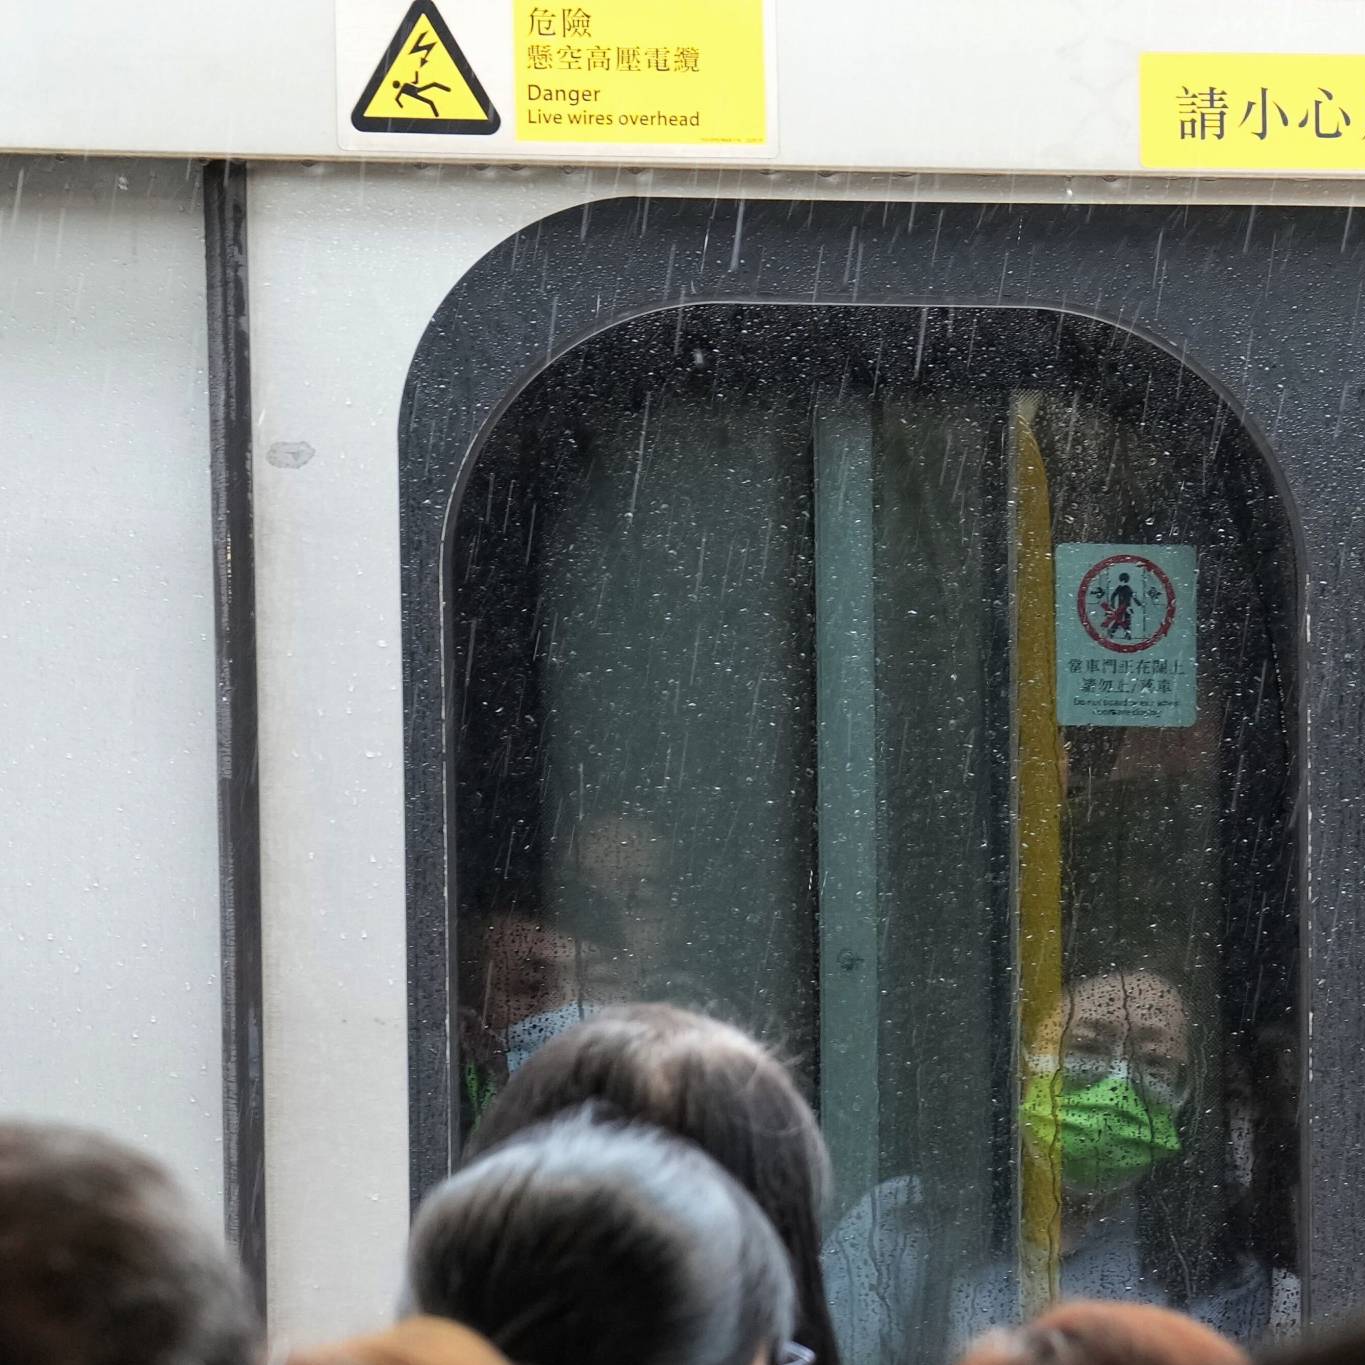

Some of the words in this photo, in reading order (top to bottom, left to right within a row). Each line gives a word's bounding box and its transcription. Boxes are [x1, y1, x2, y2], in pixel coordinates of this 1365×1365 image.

[528, 7, 592, 38] 危險
[527, 44, 700, 73] 懸空高壓電纜
[527, 84, 601, 106] Danger
[527, 108, 563, 125] Live
[567, 110, 613, 126] wires
[618, 110, 700, 127] overhead
